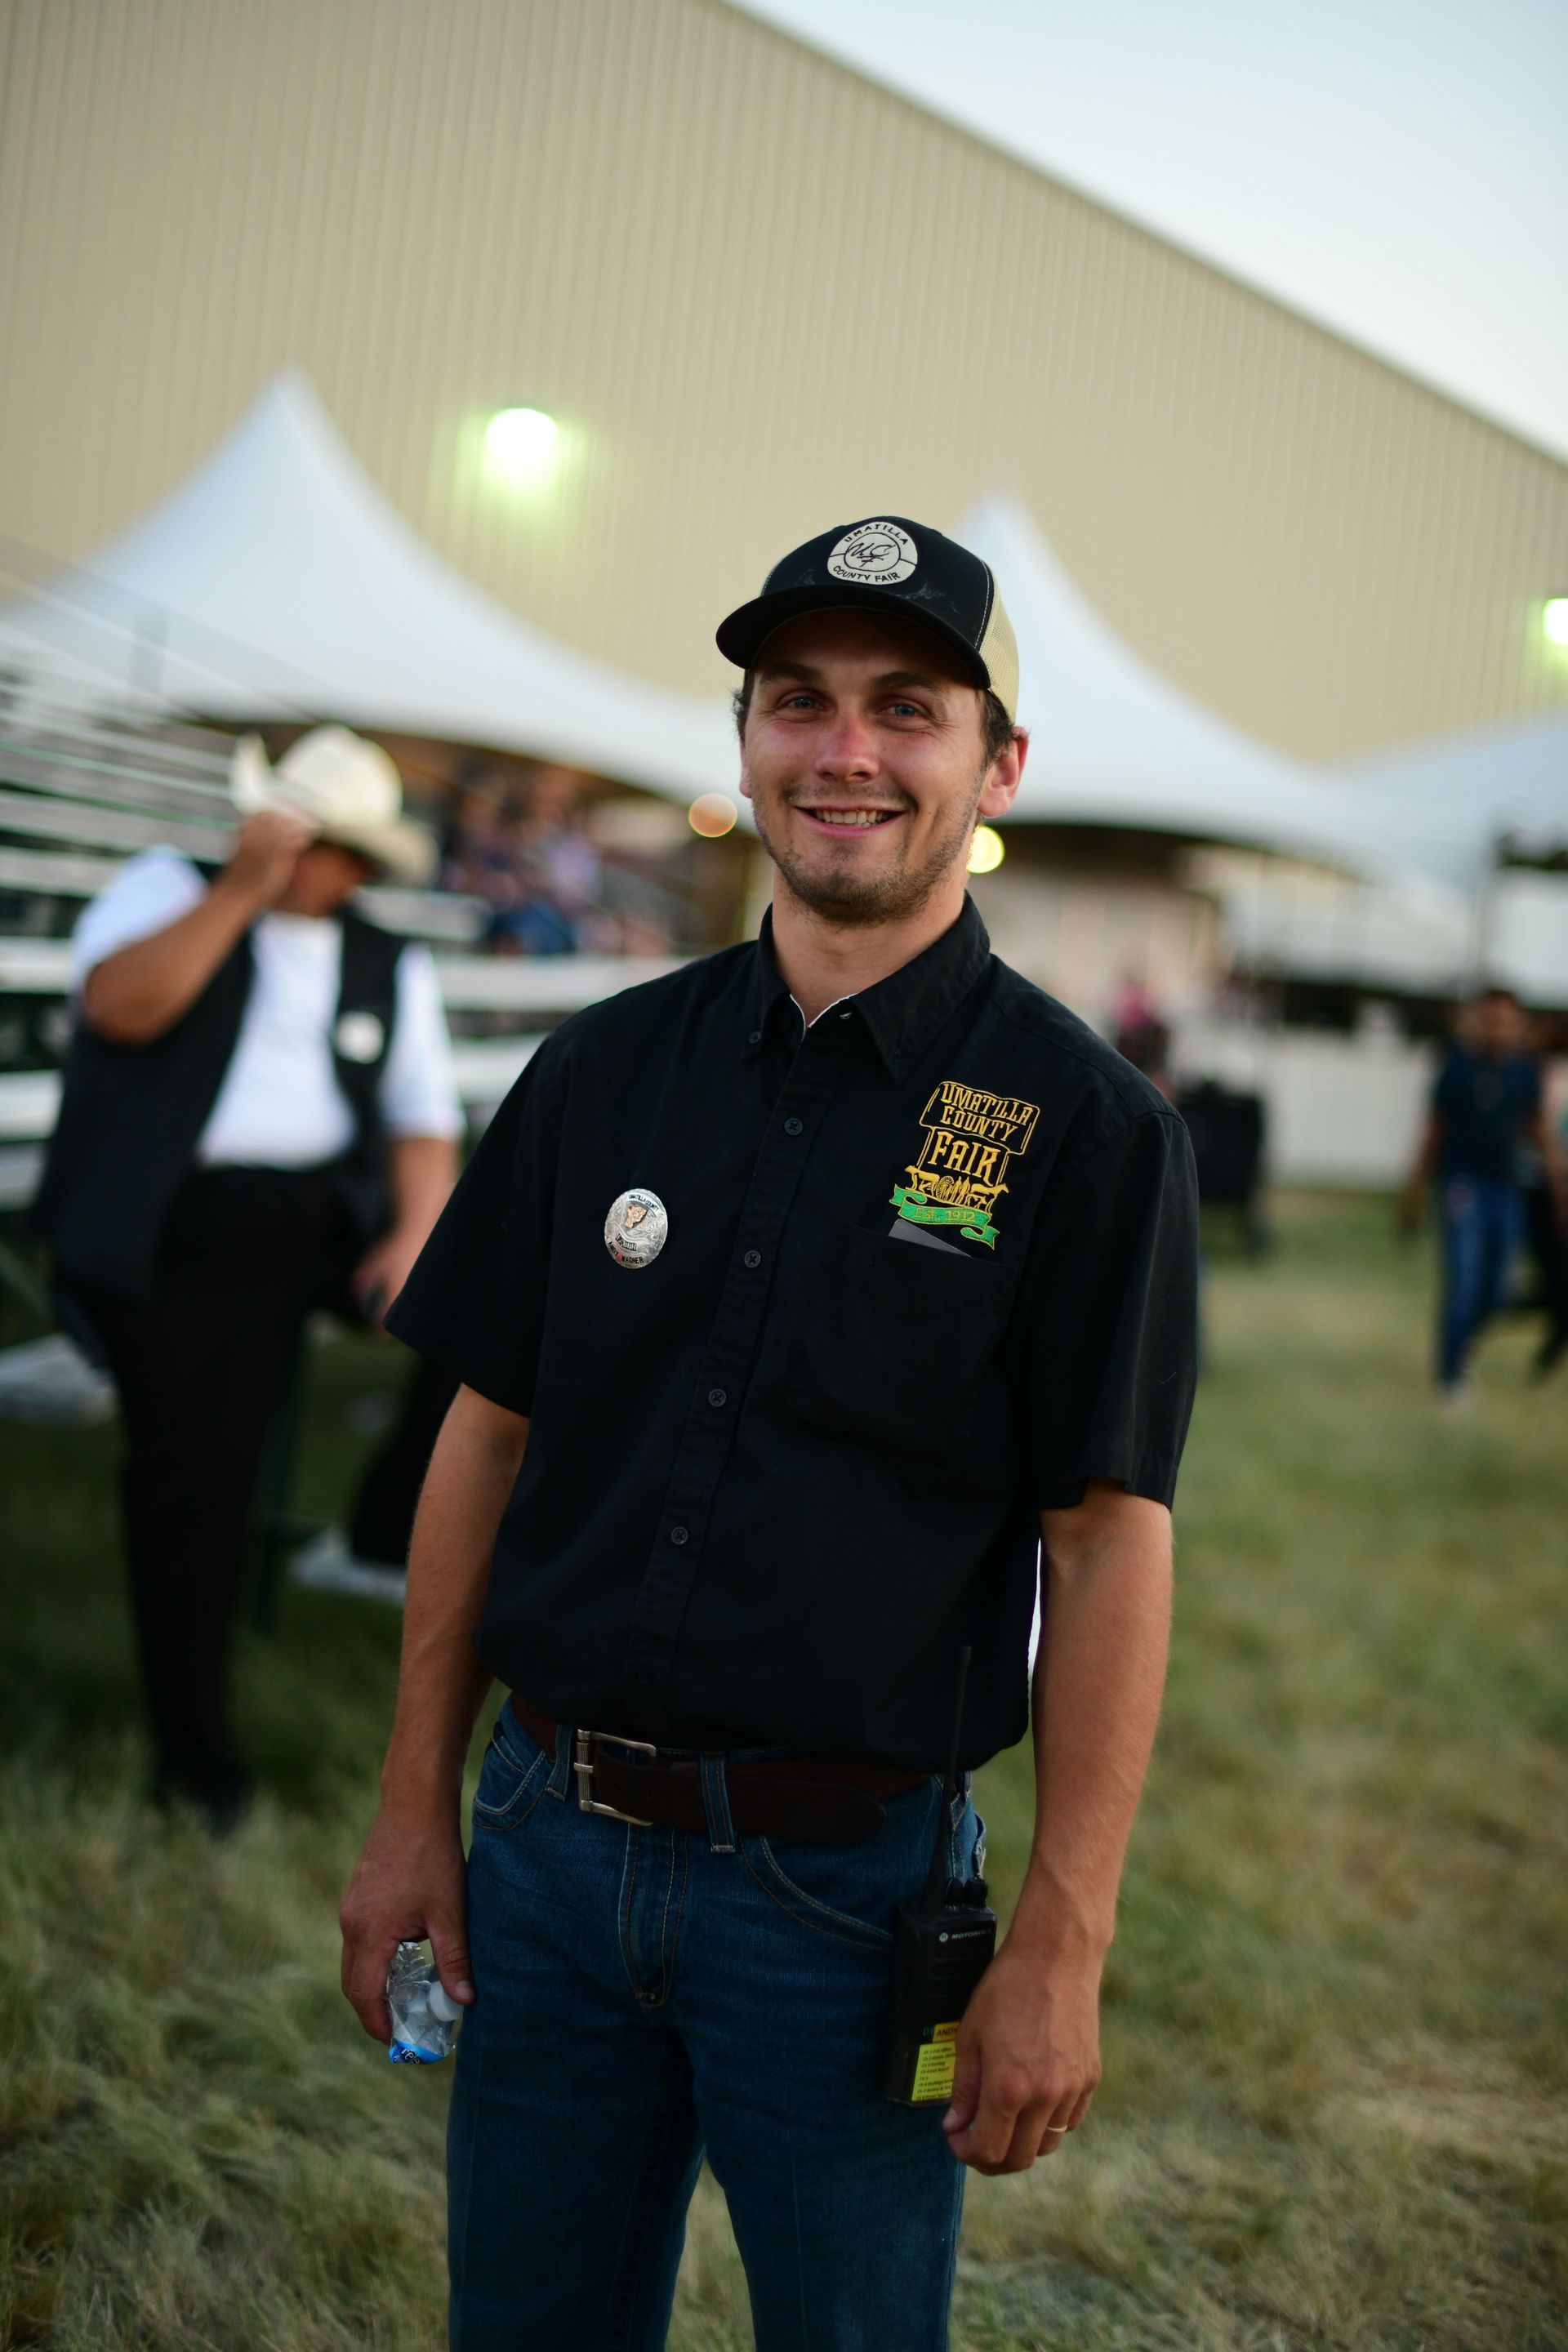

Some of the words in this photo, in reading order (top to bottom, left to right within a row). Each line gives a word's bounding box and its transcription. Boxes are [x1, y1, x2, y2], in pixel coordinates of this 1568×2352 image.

[844, 524, 908, 545] UMATILLA
[833, 565, 871, 581] COUNTY
[875, 572, 901, 582] FAIR
[940, 1083, 1033, 1125] UMATILLA
[939, 1106, 1018, 1142] COUNTY
[927, 1131, 1001, 1187] FAIR
[945, 1210, 975, 1222] 1912
